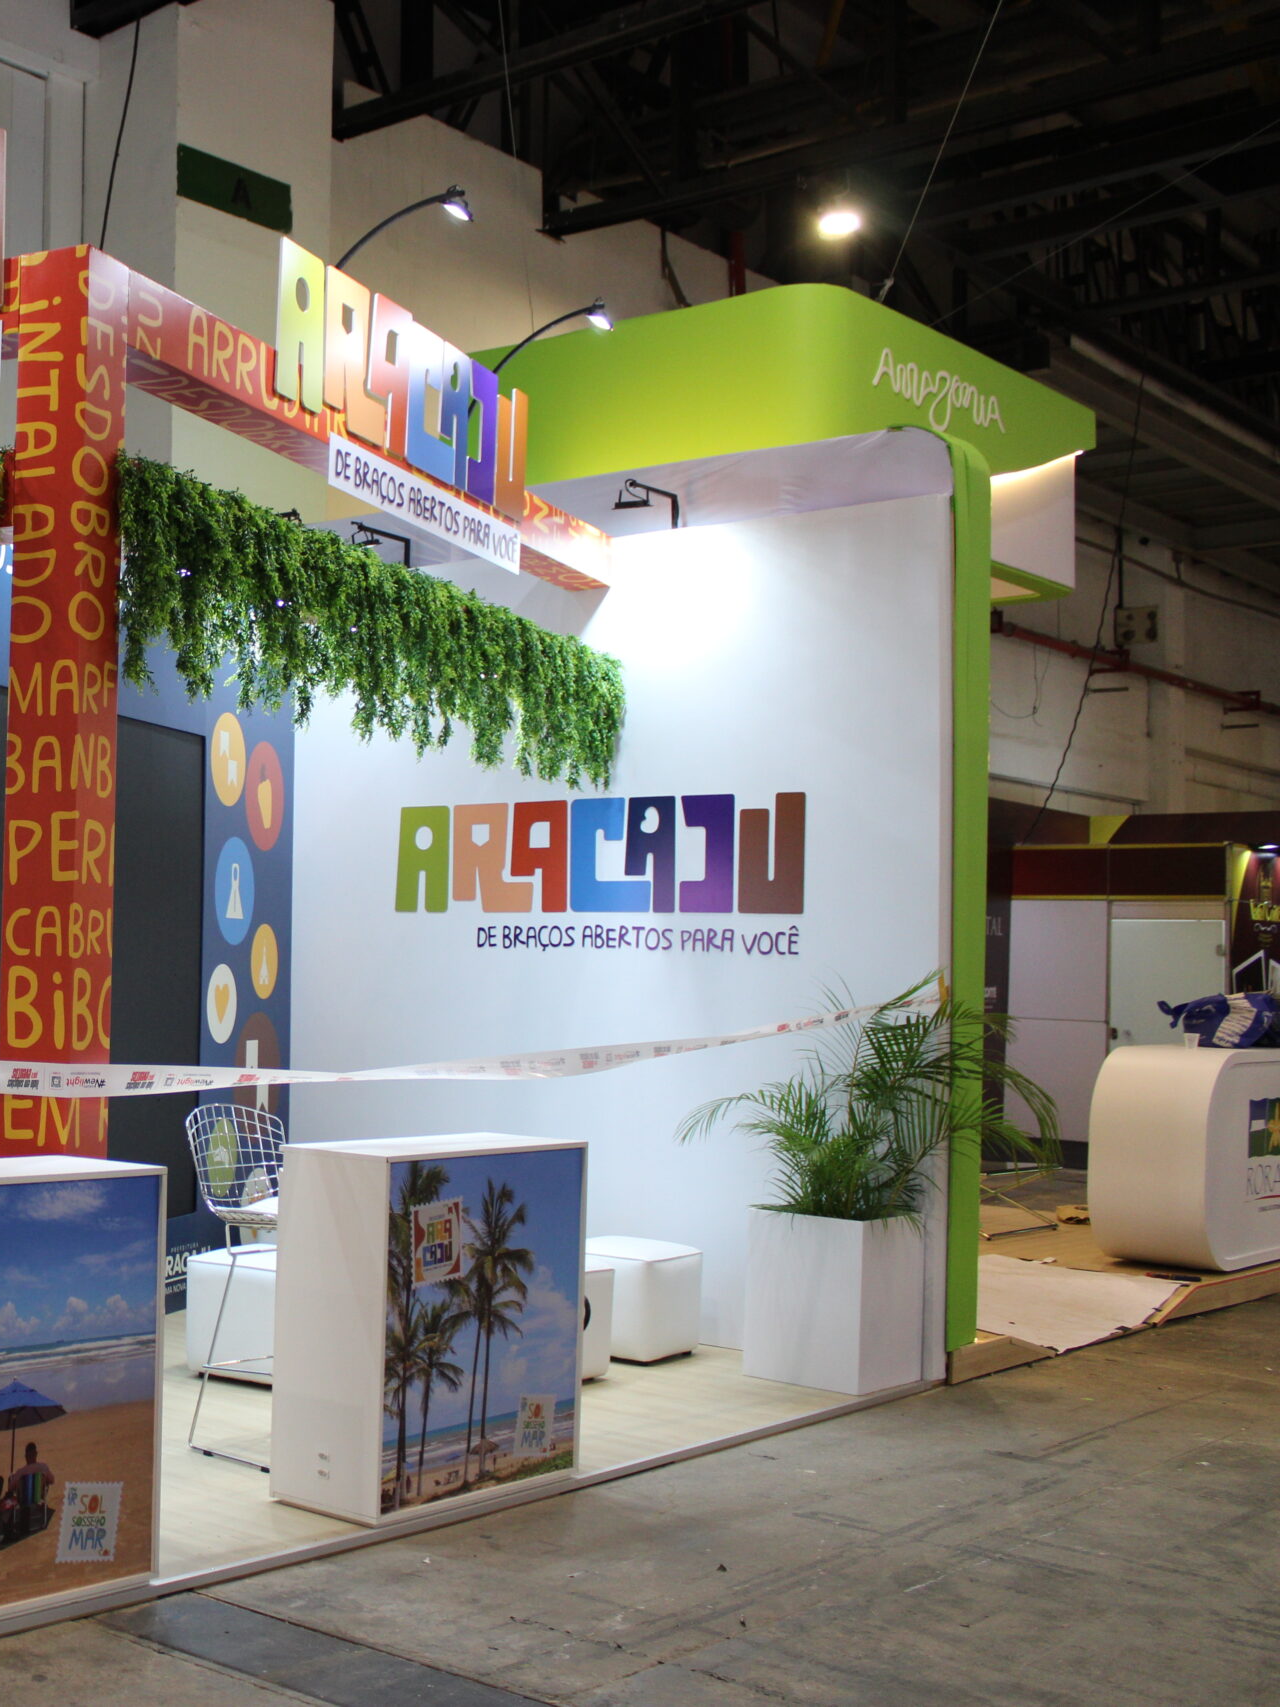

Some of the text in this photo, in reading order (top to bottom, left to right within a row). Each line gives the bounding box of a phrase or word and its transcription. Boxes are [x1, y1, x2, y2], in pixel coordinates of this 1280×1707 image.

[273, 236, 529, 514] ARACAJU
[335, 449, 351, 480] DE
[354, 457, 405, 507] BRAÇOS
[408, 486, 460, 535] ABERTOS
[463, 515, 490, 549] PARA
[493, 531, 518, 564] VOCÊ
[395, 792, 807, 914] ARACAJU
[477, 925, 799, 956] DE BRAÇOS ABERTOS PARA VOCÊ
[68, 1528, 106, 1551] MAR
[79, 1494, 106, 1514] SOL
